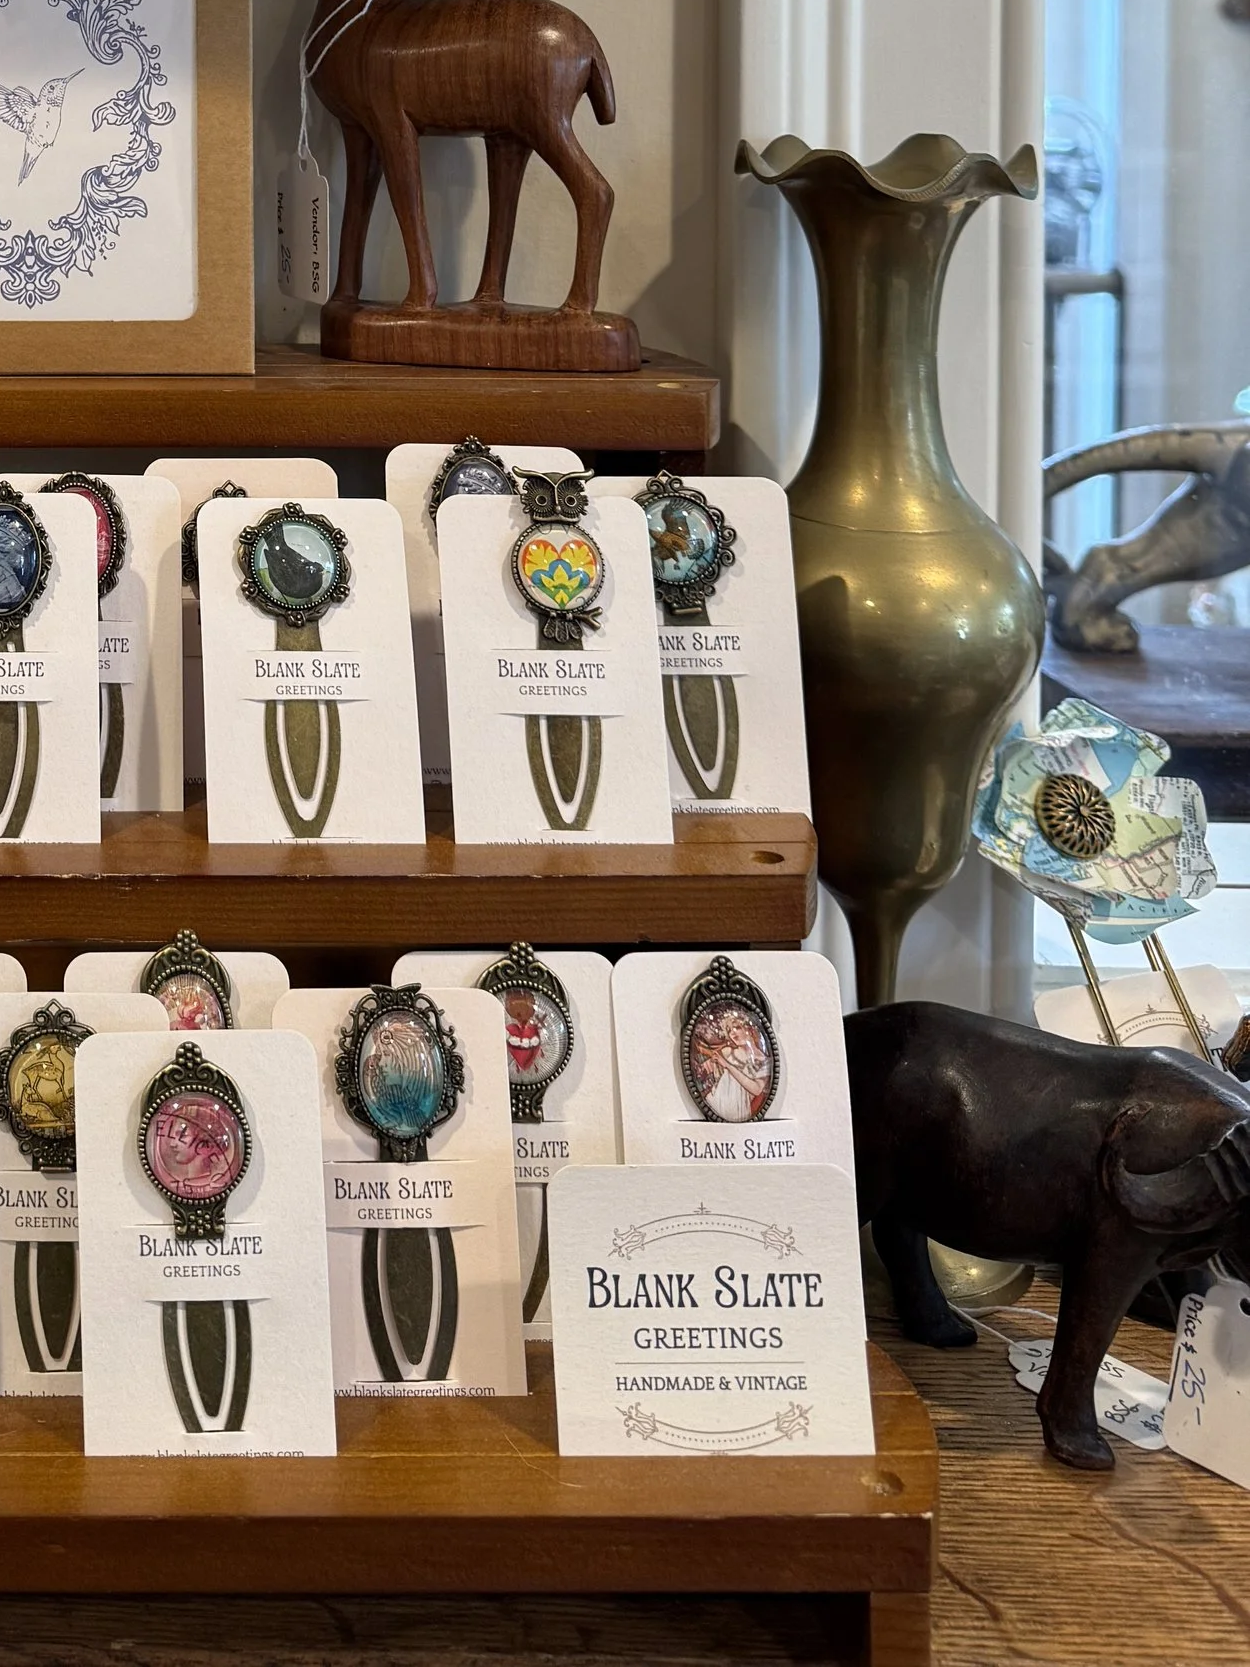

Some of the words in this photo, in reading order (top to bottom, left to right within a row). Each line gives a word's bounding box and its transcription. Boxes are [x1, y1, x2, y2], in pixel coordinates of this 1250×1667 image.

[311, 261, 320, 293] BSG
[658, 635, 686, 651] ANK
[693, 632, 741, 651] SLATE
[254, 659, 305, 678] BLANK
[312, 658, 361, 678] SLATE
[497, 658, 549, 678] BLANK
[555, 658, 606, 679] SLATE
[275, 685, 343, 695] GREETINGS
[518, 685, 587, 696] GREETINGS
[517, 1137, 570, 1159] SLATE
[680, 1137, 736, 1159] BLANK
[743, 1138, 795, 1159] SLATE
[334, 1177, 391, 1200] BLANK
[398, 1177, 454, 1199] SLATE
[357, 1207, 433, 1220] GREETINGS
[139, 1234, 198, 1256] BLANK
[162, 1264, 241, 1277] GREETINGS
[586, 1266, 699, 1309] BLANK
[714, 1264, 824, 1309] SLATE
[1184, 1296, 1203, 1338] Price
[633, 1327, 783, 1349] GREETINGS
[616, 1376, 715, 1391] HANDMADE
[718, 1376, 731, 1390] &
[735, 1376, 807, 1390] VINTAGE
